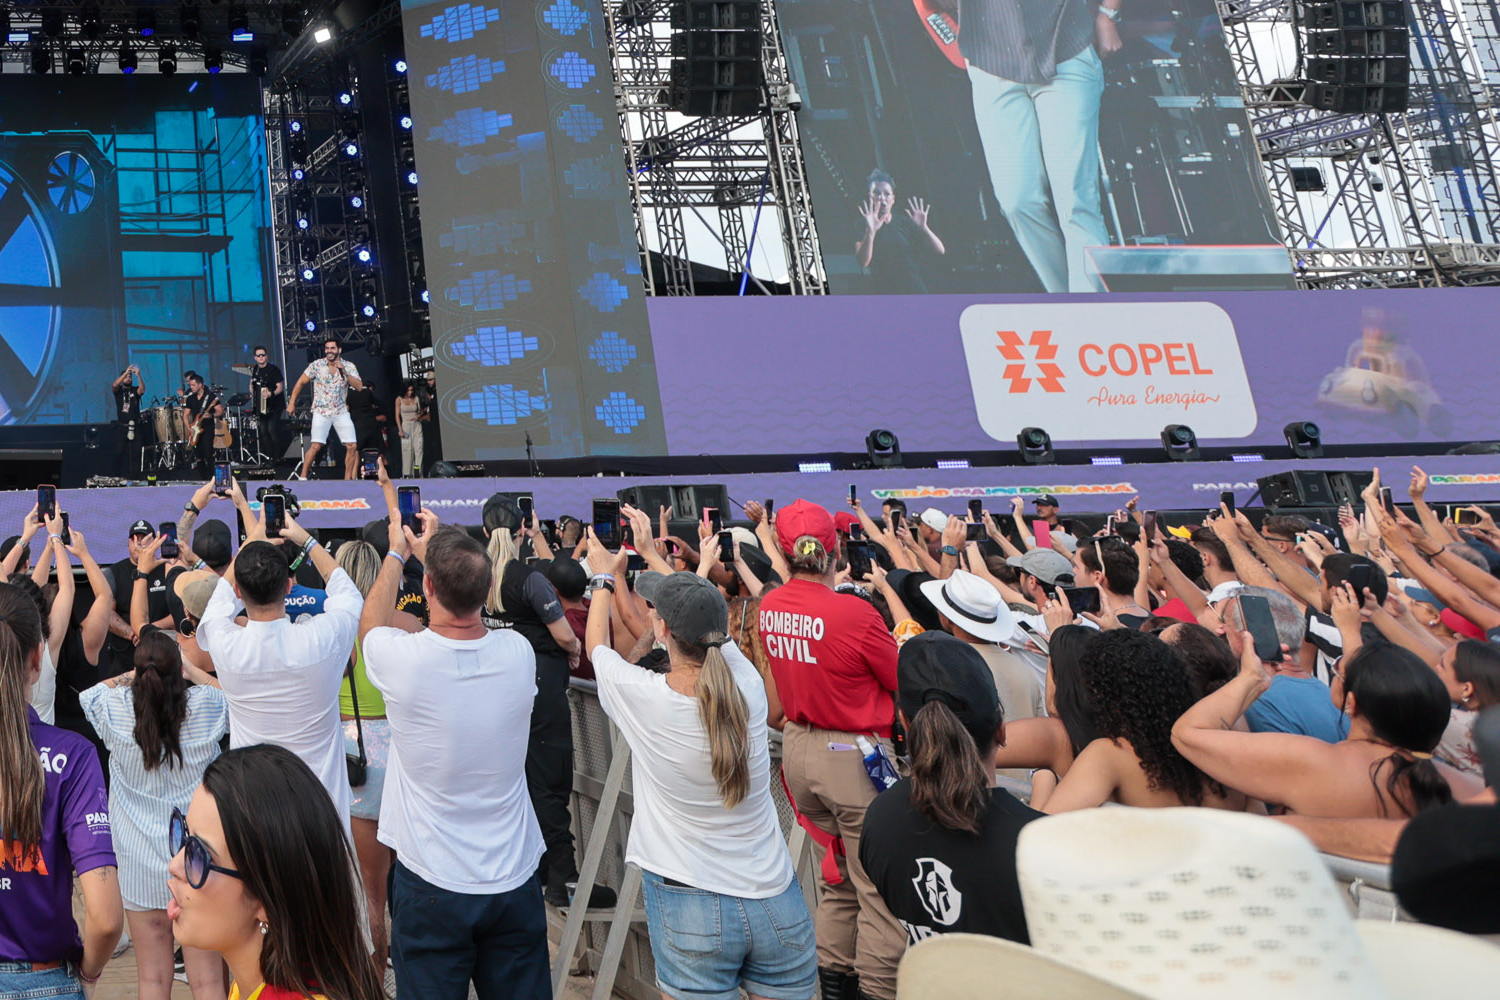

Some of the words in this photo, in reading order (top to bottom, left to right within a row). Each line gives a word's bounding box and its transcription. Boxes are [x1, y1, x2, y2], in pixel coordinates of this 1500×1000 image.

[1078, 342, 1214, 377] COPEL
[1087, 386, 1137, 407] Pura
[1145, 385, 1220, 411] Energia
[284, 595, 316, 607] DUÇÃO
[760, 610, 825, 641] BOMBEIRO
[766, 634, 817, 664] CIVIL
[85, 812, 108, 825] PAR
